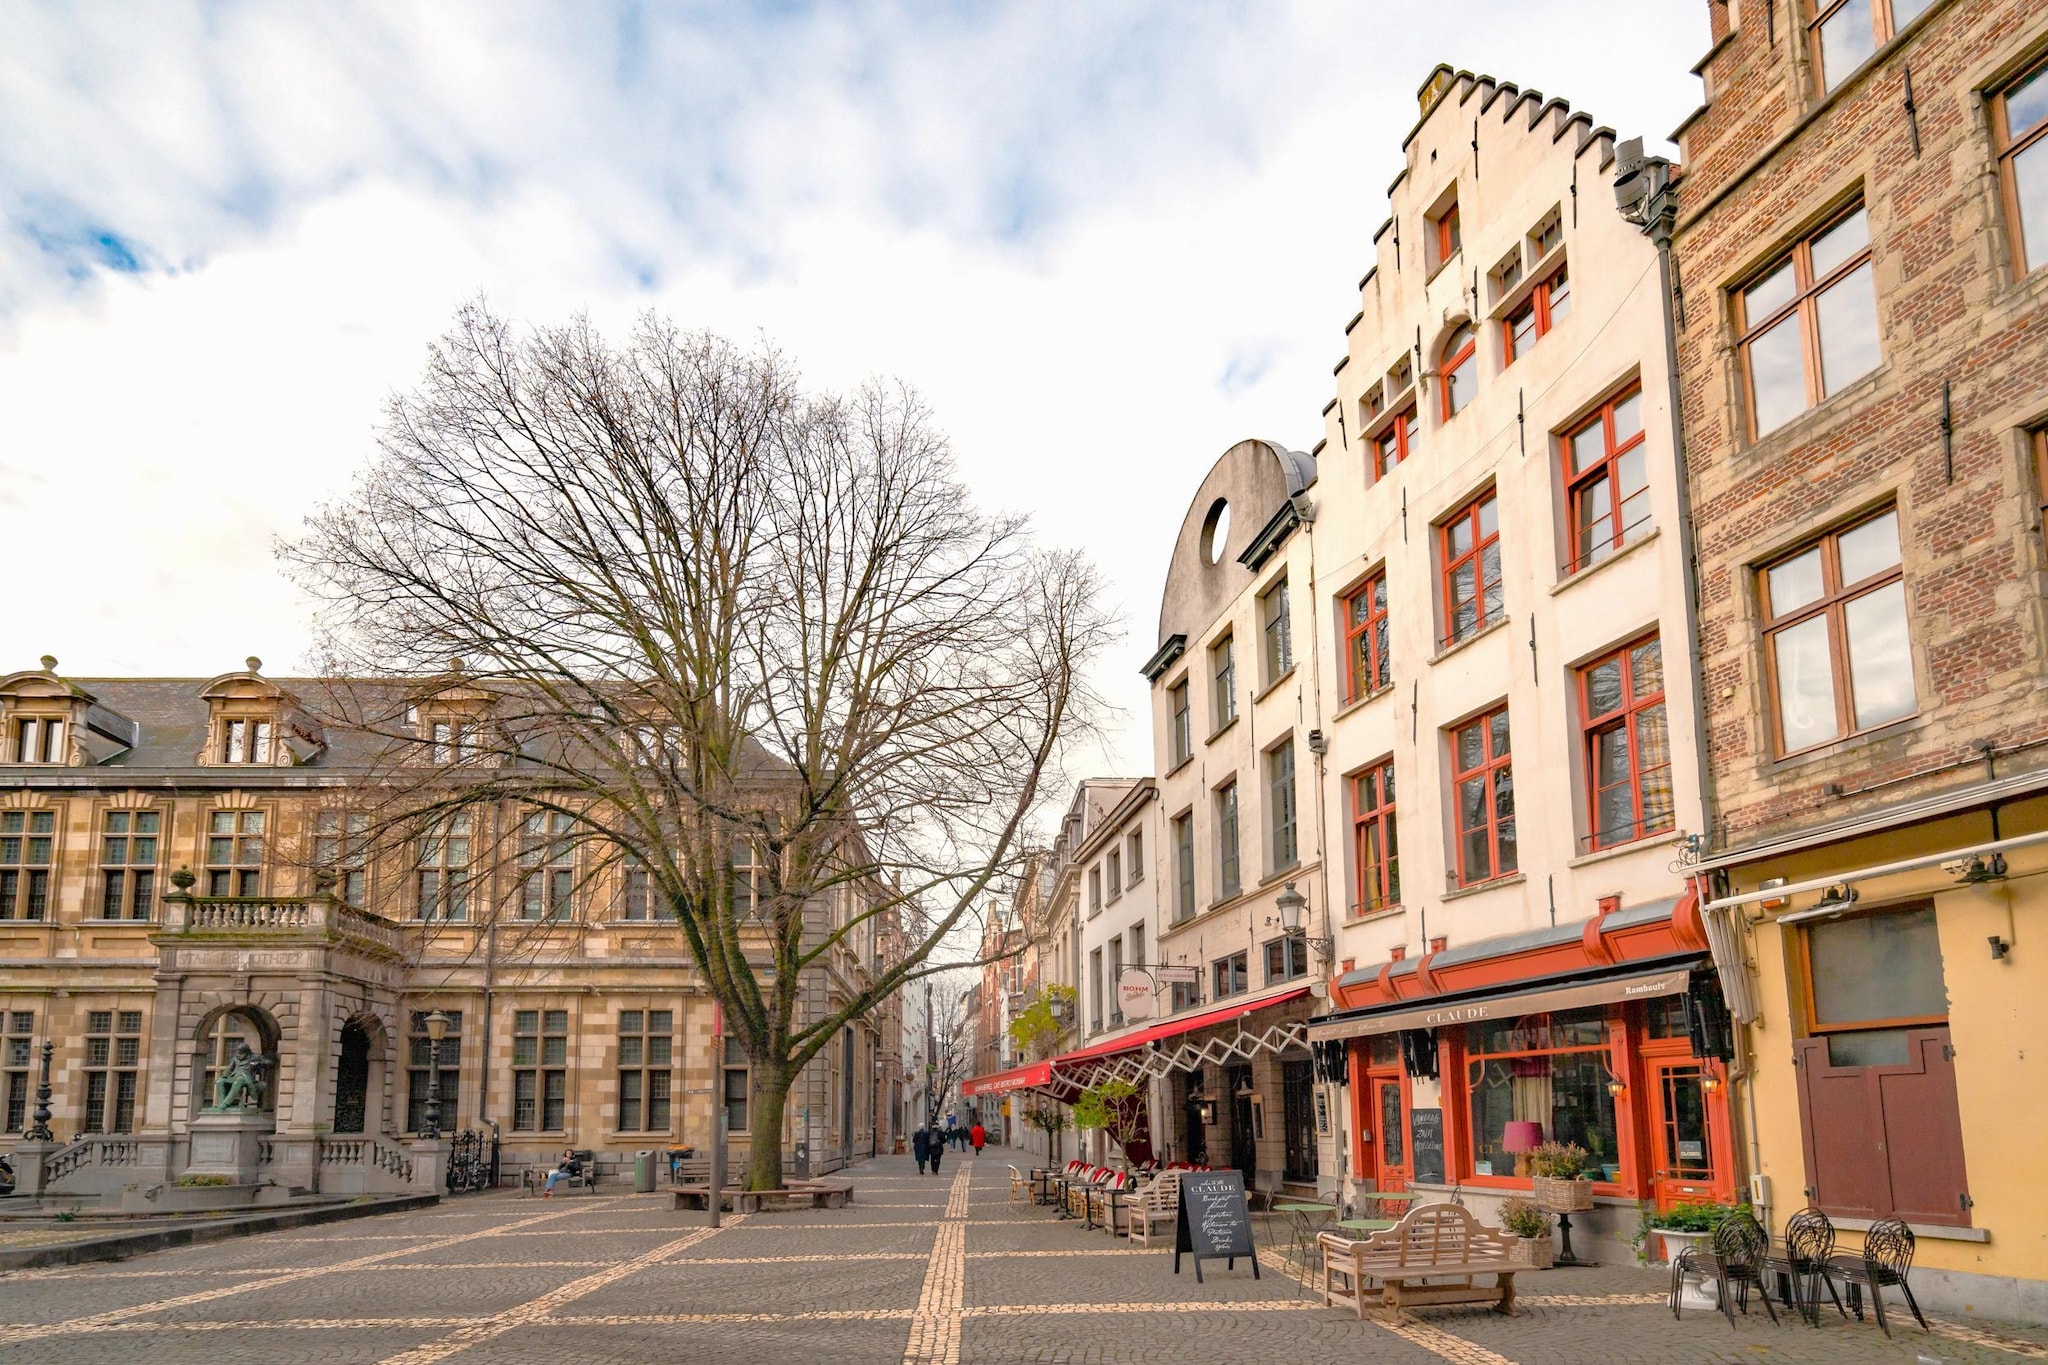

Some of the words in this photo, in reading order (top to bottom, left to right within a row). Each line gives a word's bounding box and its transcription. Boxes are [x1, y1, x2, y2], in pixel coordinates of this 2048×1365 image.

[180, 952, 304, 965] STADBIBIOTHEEK
[1122, 985, 1149, 993] BOHM
[1625, 982, 1666, 995] Rombouts
[1426, 1006, 1489, 1024] CLAUDE
[1191, 1184, 1236, 1193] CLAUDE
